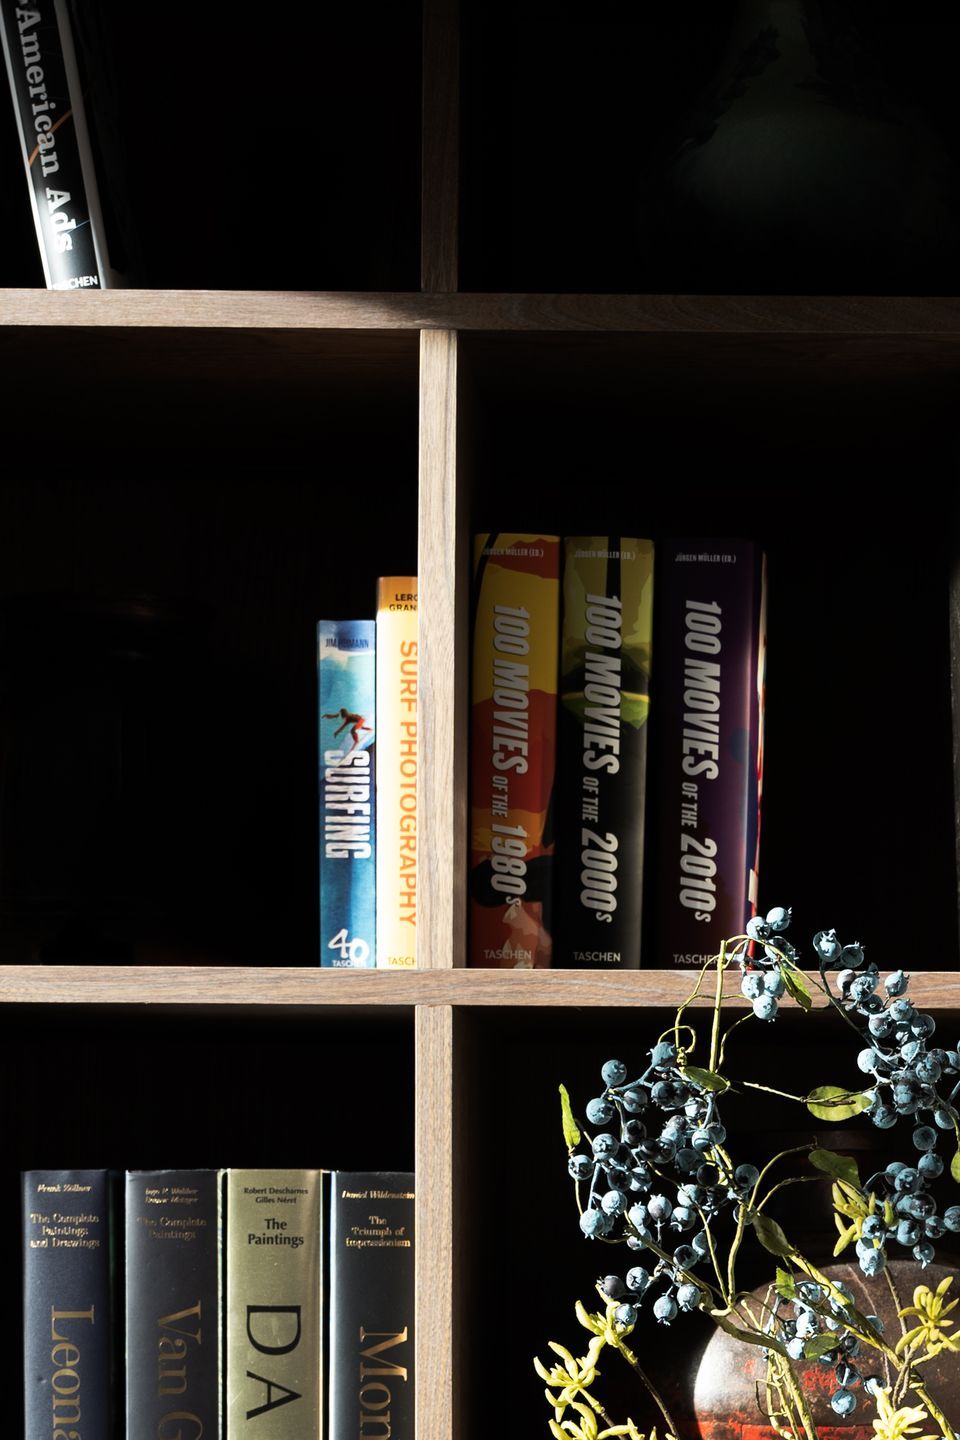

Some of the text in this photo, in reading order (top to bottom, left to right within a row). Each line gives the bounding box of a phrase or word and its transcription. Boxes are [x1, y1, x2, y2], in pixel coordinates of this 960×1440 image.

[15, 7, 77, 254] American Ads
[490, 605, 530, 907] 100 MOVIES OF THE 1980s
[580, 593, 623, 923] 100 MOVIES OF THE 2000s
[679, 600, 722, 923] 100 MOVIES OF THE 2010s
[399, 640, 417, 927] SURF PHOTOGRAPHY
[324, 749, 372, 859] SURFING
[327, 928, 370, 961] 40
[484, 949, 532, 960] TASCHEN
[574, 951, 621, 962] TASCHEN
[244, 1187, 267, 1195] Robert
[255, 1196, 275, 1204] Gilles
[30, 1213, 100, 1225] The Complete
[264, 1218, 288, 1231] The
[368, 1215, 387, 1226] The
[42, 1226, 89, 1238] Paintings
[351, 1226, 406, 1237] Triumph of
[29, 1238, 101, 1250] and Drawings
[248, 1233, 305, 1249] Paintings
[157, 1299, 202, 1395] Van
